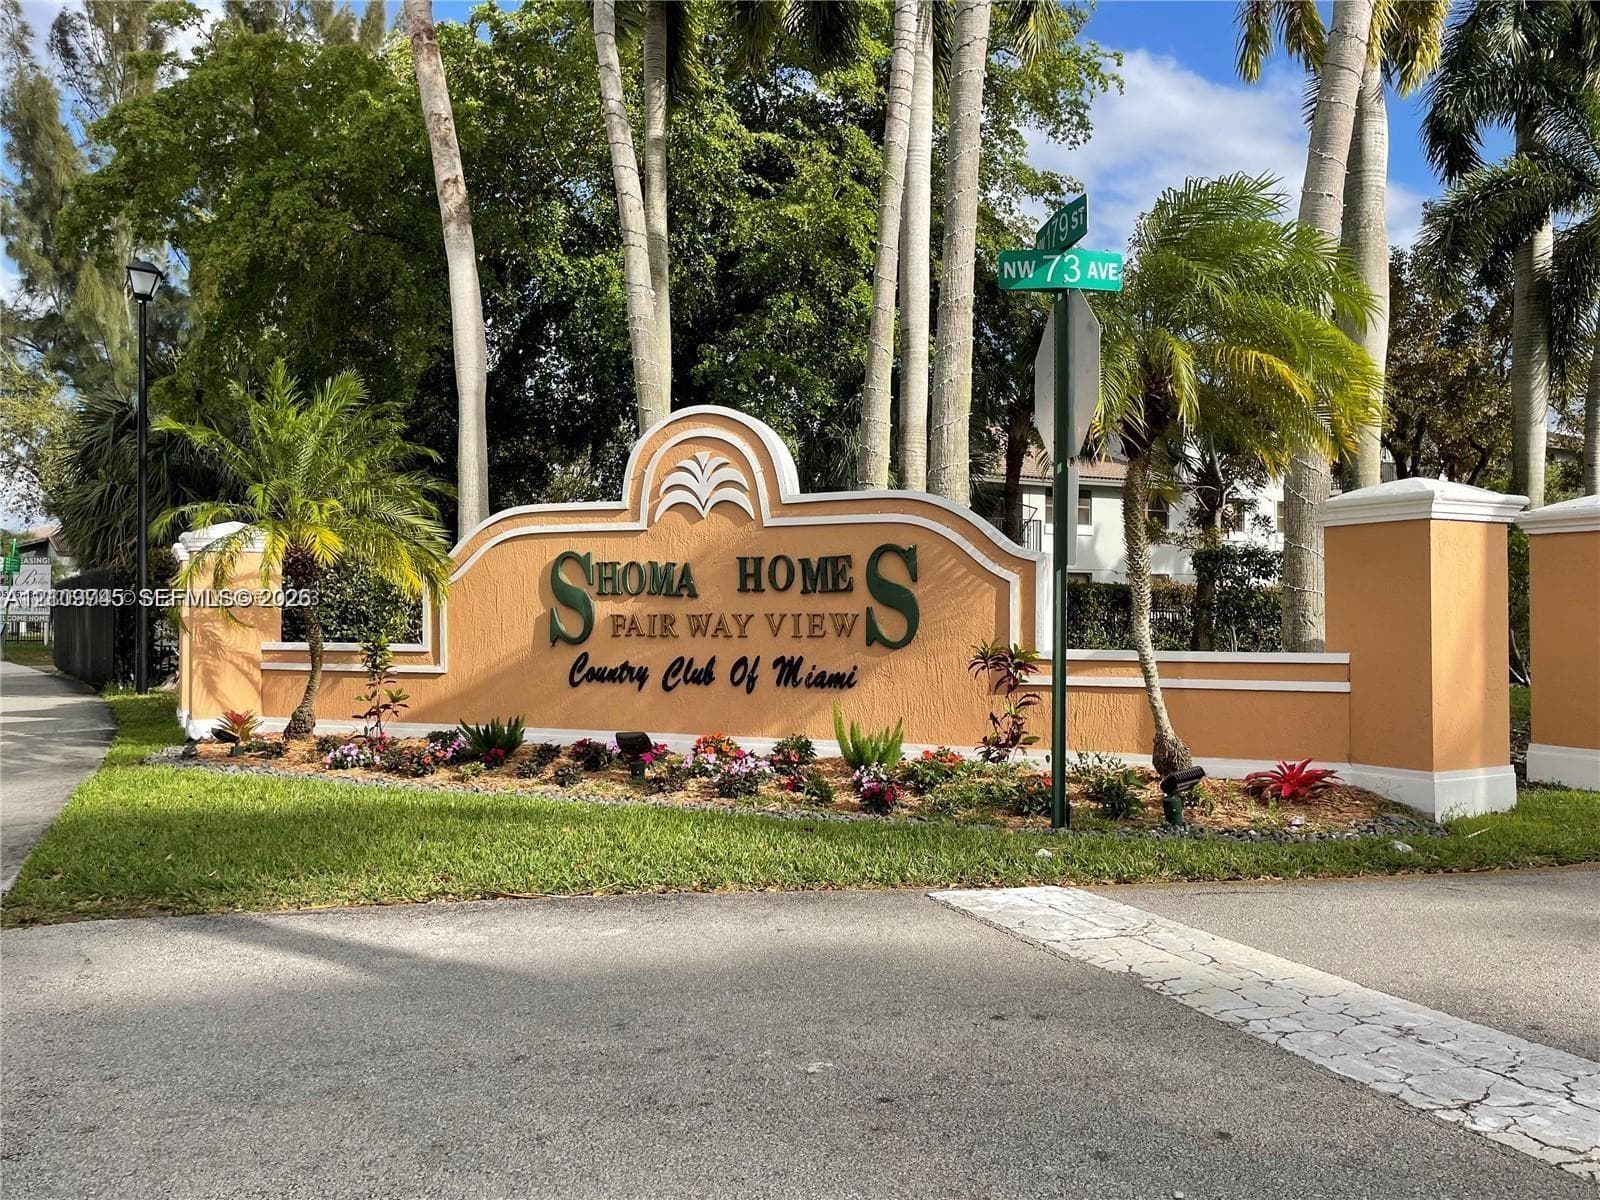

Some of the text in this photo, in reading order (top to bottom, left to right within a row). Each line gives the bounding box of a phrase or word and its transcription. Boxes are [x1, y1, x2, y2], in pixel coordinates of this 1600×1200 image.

[1046, 213, 1068, 249] 179
[1071, 206, 1085, 230] ST
[1003, 254, 1119, 283] NW 73 AVE
[550, 543, 920, 649] SHOMA HOMES
[610, 613, 860, 639] FAIR WAY VIEW
[568, 651, 858, 694] Country Club Of Miami
